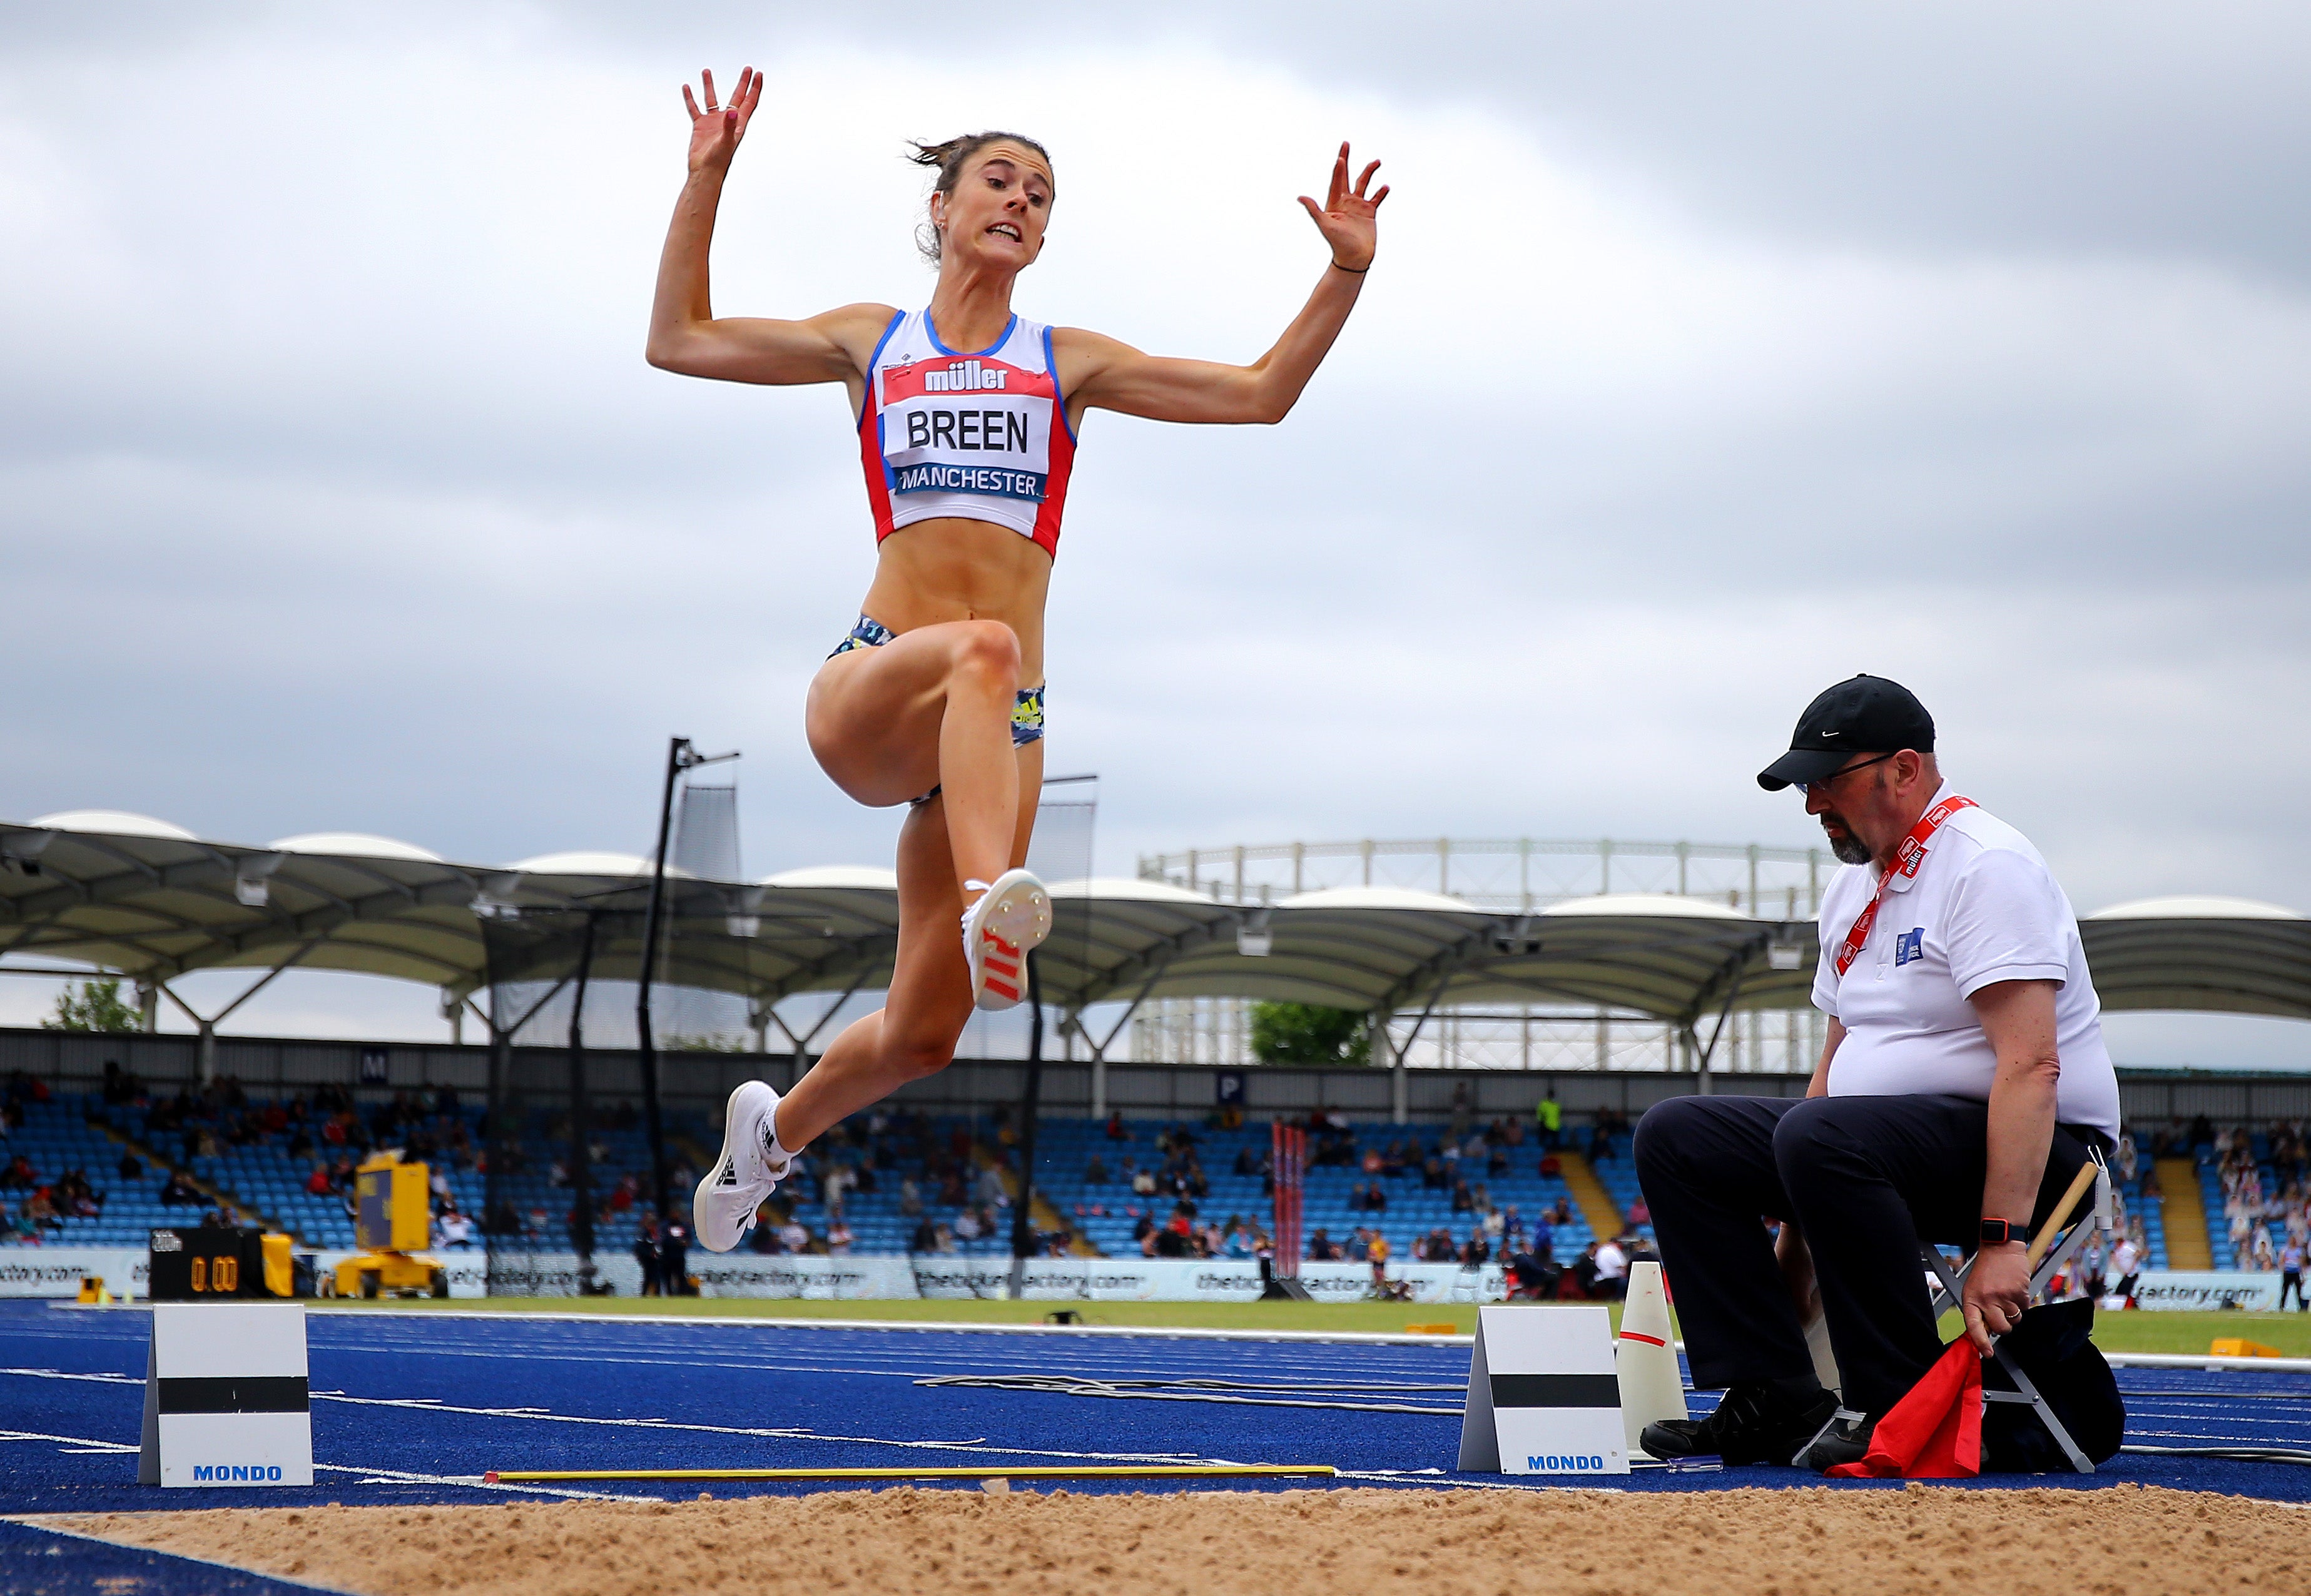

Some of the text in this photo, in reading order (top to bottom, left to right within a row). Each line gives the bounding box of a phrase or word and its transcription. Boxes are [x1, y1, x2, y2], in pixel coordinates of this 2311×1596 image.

[925, 360, 1008, 392] müller
[907, 410, 1027, 454] BREEN
[902, 467, 1036, 496] MANCHESTER
[1221, 1076, 1239, 1099] P
[193, 1465, 282, 1482] MONDO
[1528, 1455, 1603, 1470] MONDO
